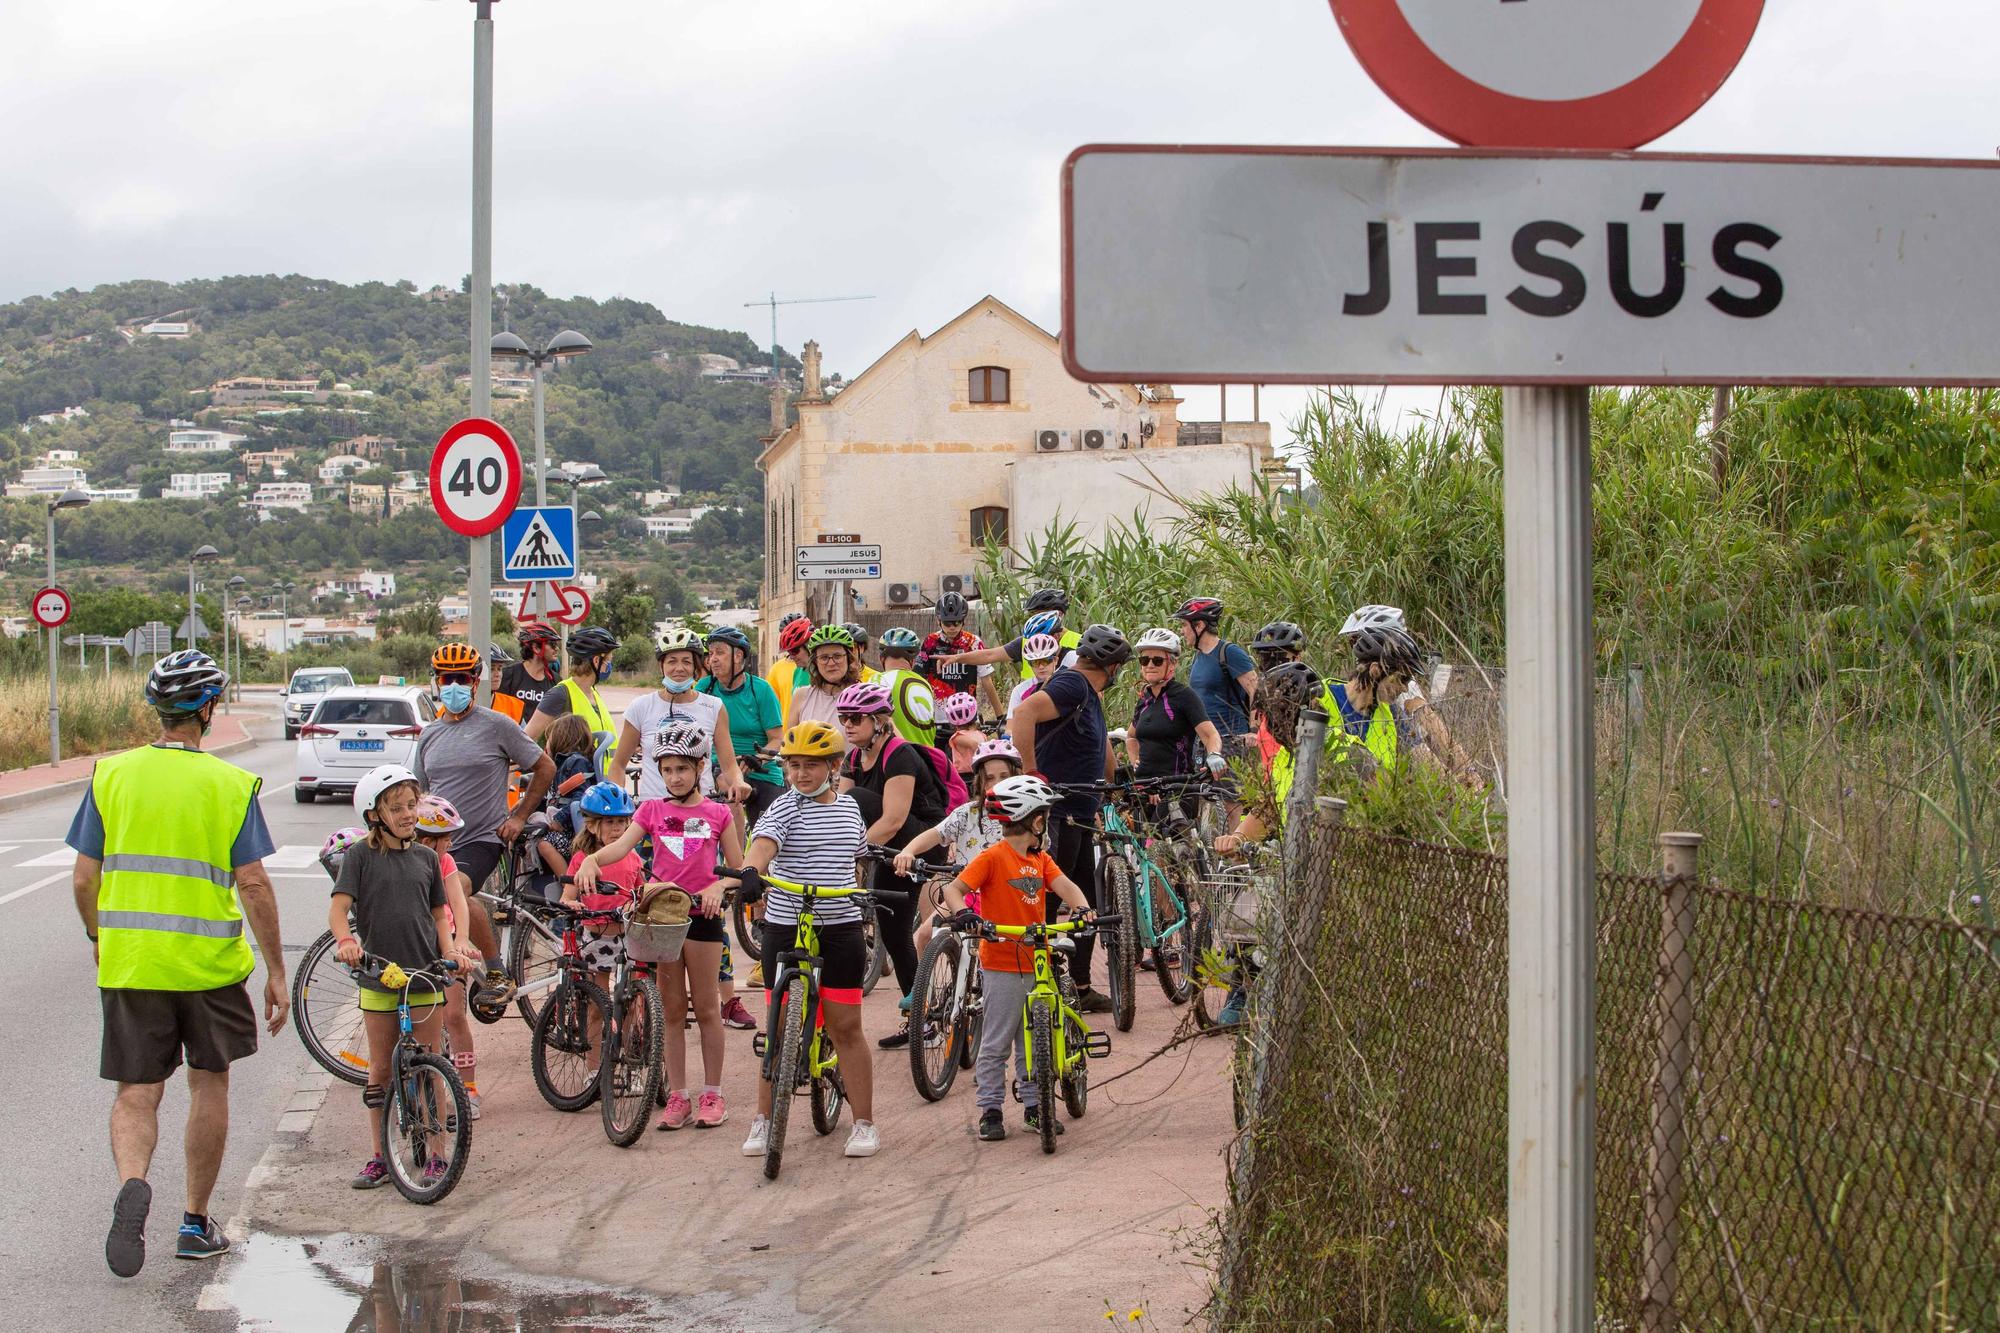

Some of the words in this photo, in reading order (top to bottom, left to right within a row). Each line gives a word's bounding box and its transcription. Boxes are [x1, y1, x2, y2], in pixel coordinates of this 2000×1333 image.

[1341, 192, 1785, 318] JESÚS
[448, 457, 502, 497] 40
[826, 535, 852, 543] EI-100
[516, 689, 544, 702] adid
